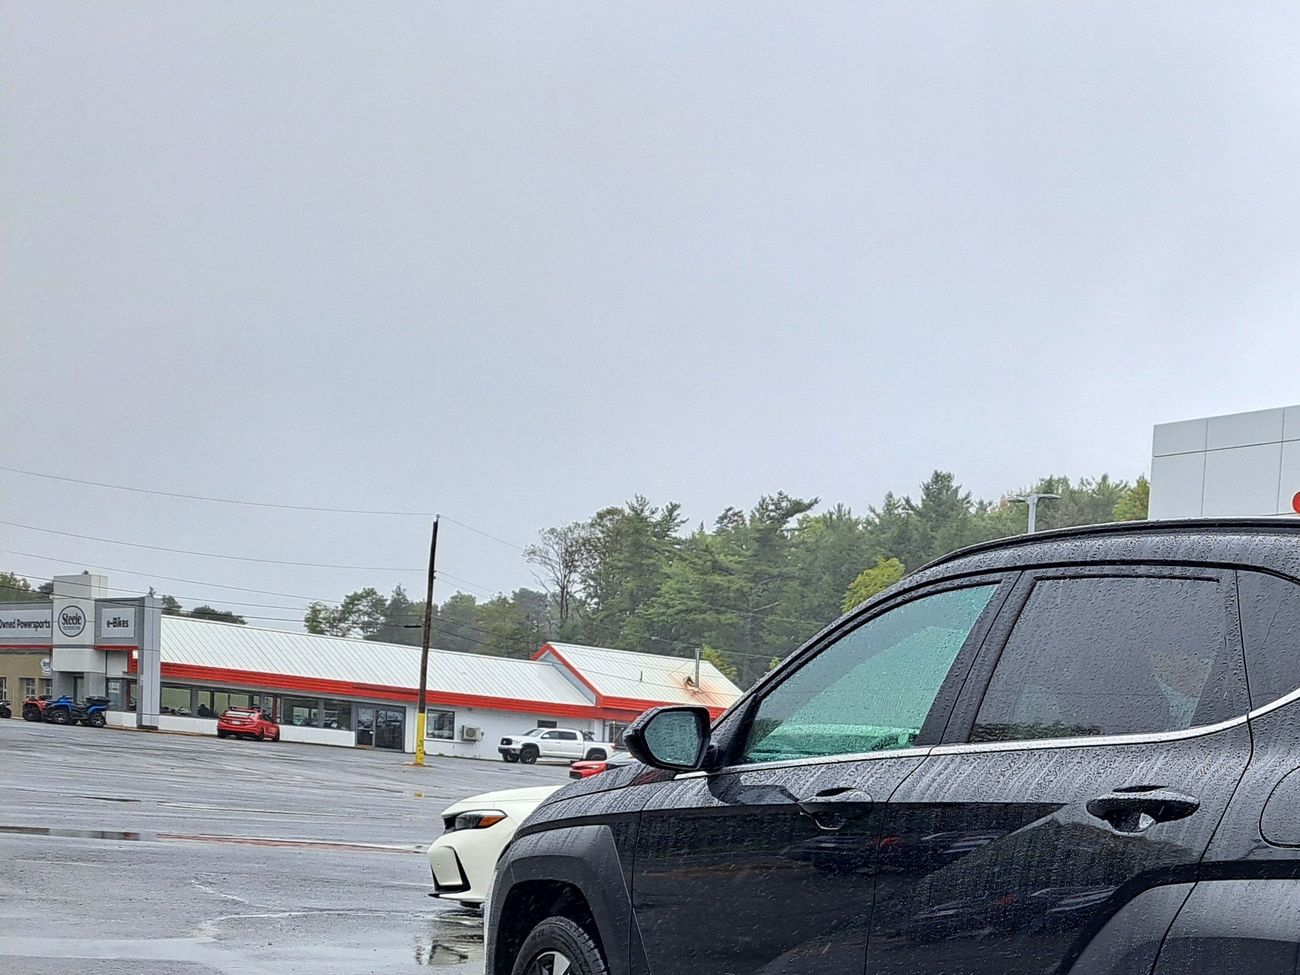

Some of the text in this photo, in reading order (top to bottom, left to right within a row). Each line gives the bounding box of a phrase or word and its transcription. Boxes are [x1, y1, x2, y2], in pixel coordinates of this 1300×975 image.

[16, 618, 51, 632] Powersports
[61, 612, 82, 626] Steele
[106, 616, 129, 628] e-Bikes
